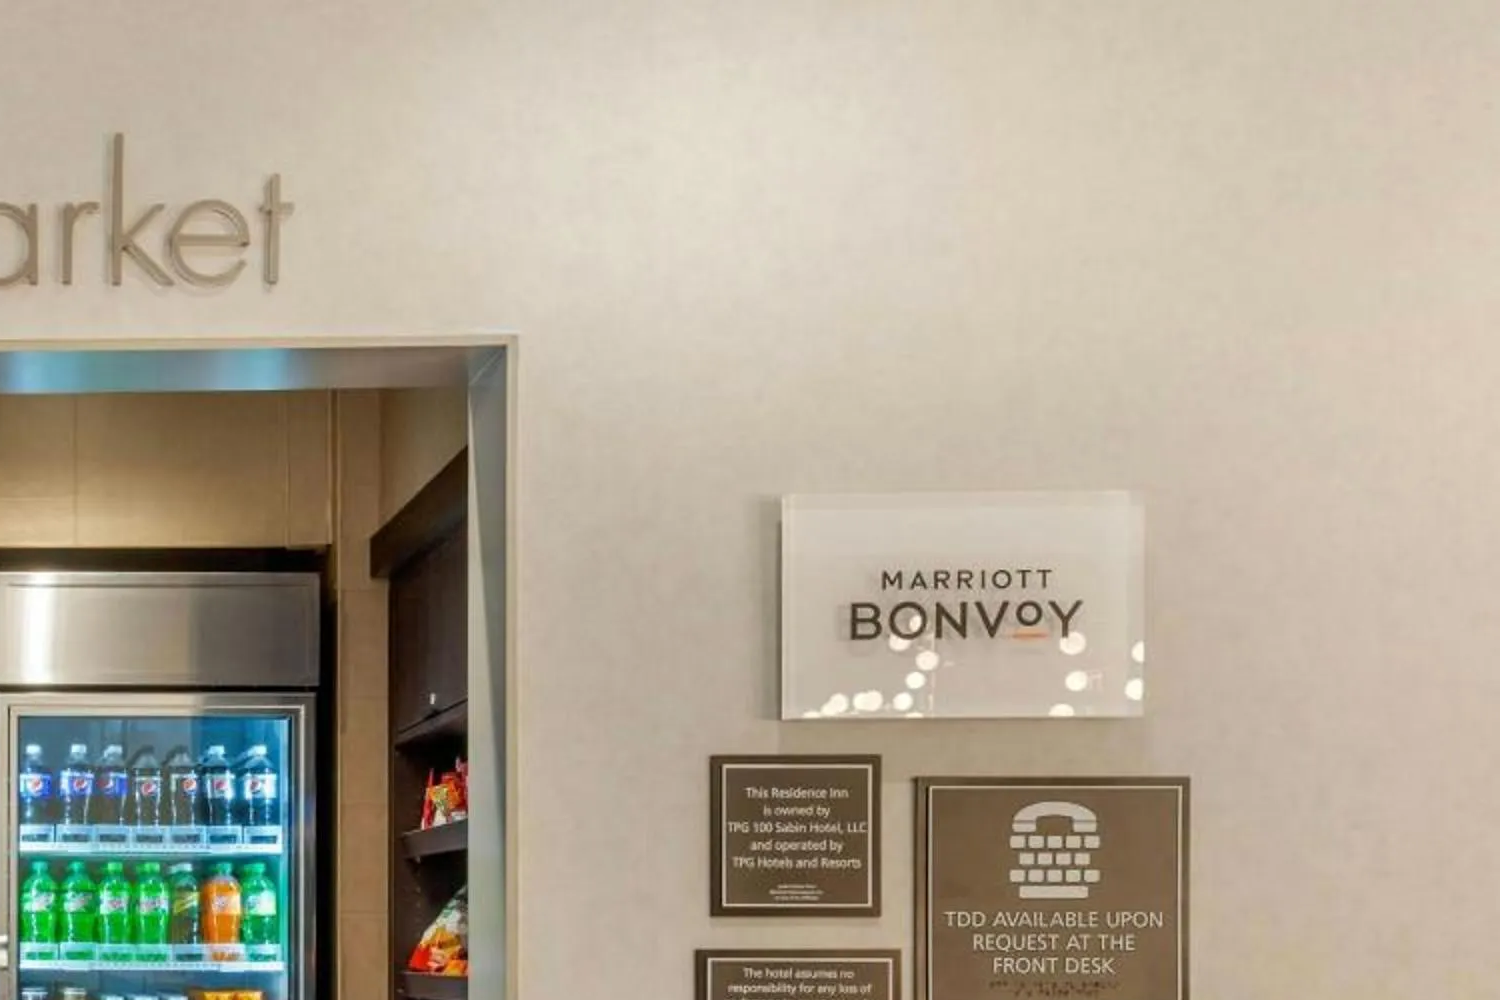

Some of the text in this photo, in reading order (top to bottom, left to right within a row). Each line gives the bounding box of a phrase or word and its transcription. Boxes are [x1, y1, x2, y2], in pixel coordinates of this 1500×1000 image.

[880, 569, 1053, 590] MARRIOTT
[850, 600, 1083, 640] BONVOY
[745, 787, 849, 799] This Residence Inn
[763, 804, 830, 818] is owned by
[728, 821, 749, 833] TPG
[753, 821, 773, 833] 100
[847, 821, 868, 833] LLC
[750, 840, 843, 854] and operated by
[732, 856, 861, 869] TPG Hotels and Resorts
[944, 911, 1163, 928] TDD AVAILABLE UPON
[973, 934, 1135, 951] REQUEST AT THE
[992, 957, 1116, 974] FRONT DESK
[743, 967, 763, 978] The
[765, 967, 793, 979] hotel
[840, 970, 855, 979] no
[799, 982, 816, 993] for
[817, 985, 837, 996] any
[860, 983, 873, 993] of
